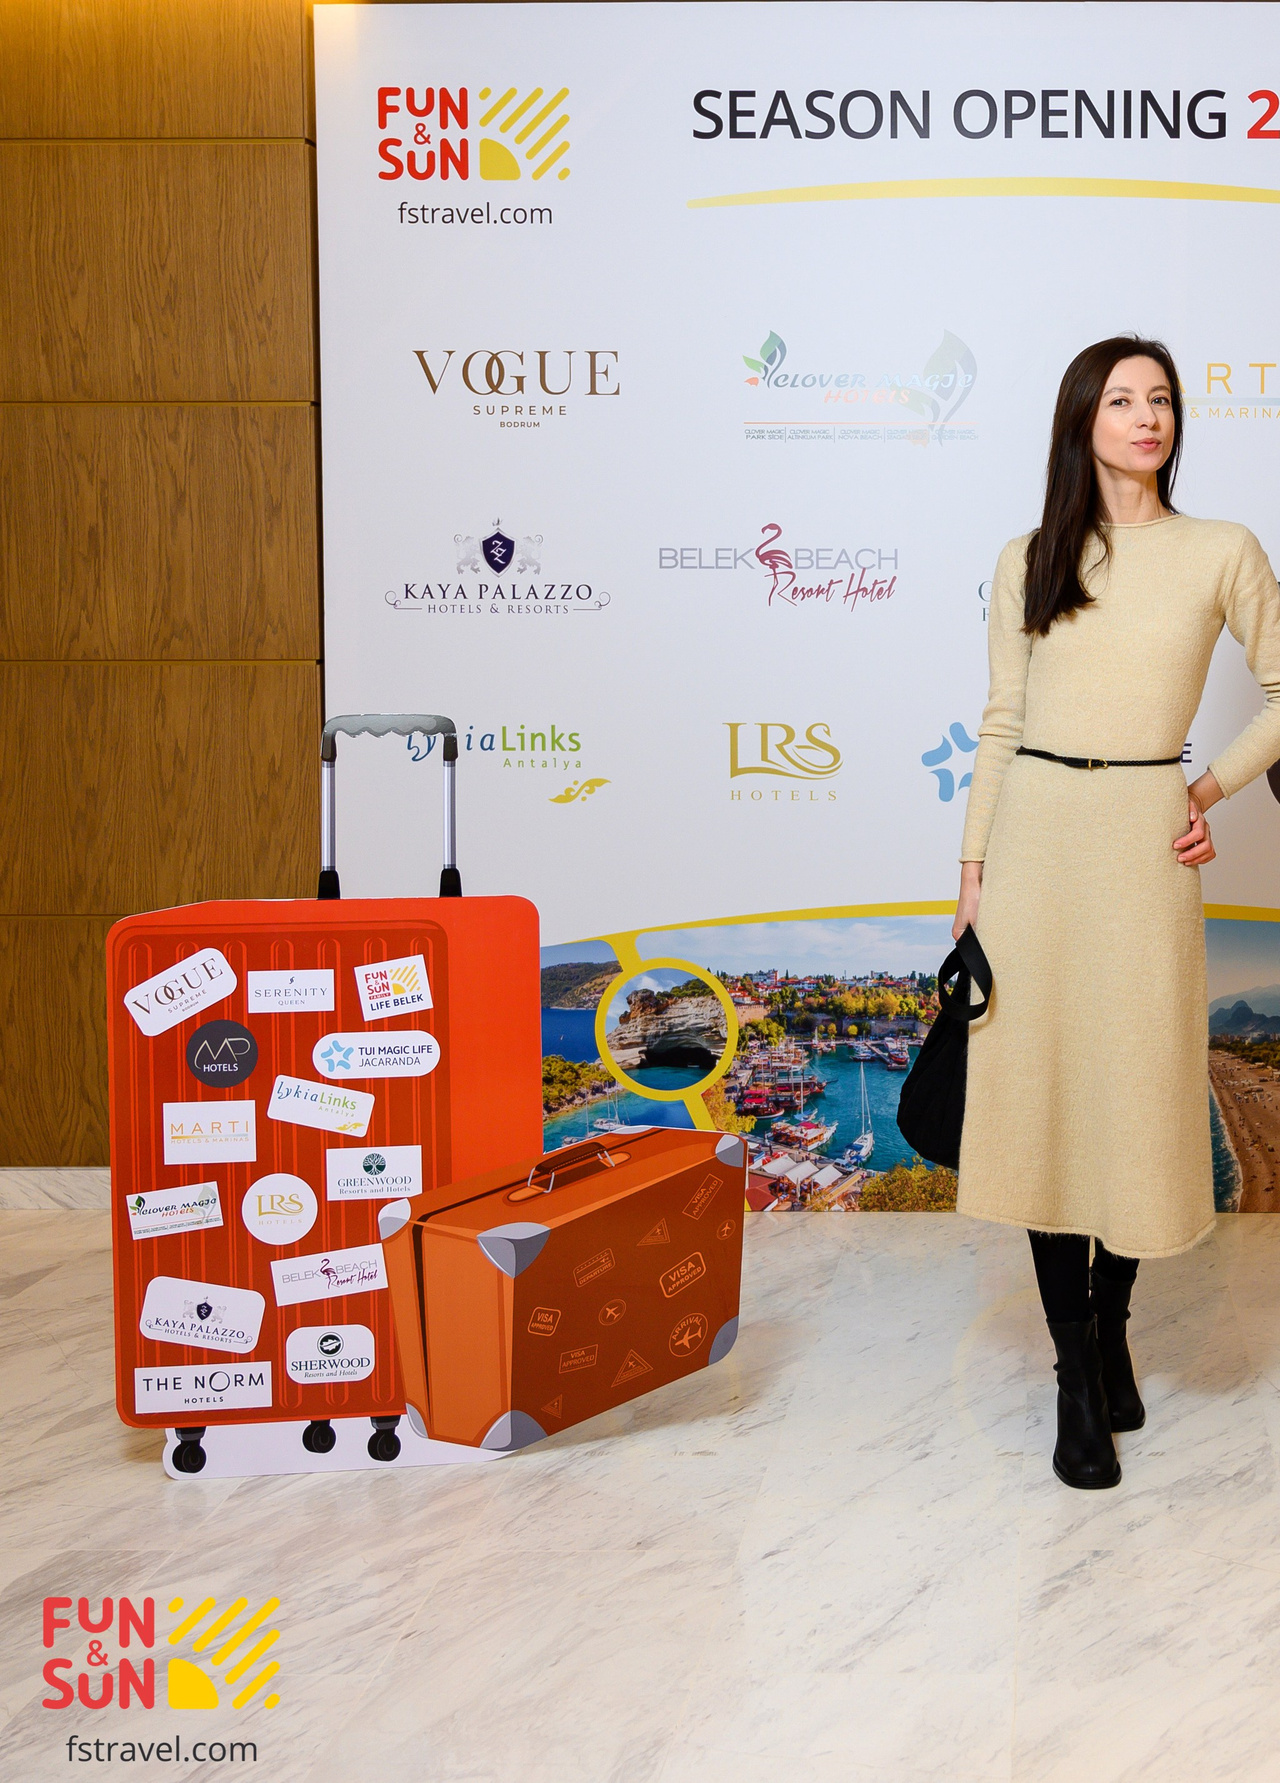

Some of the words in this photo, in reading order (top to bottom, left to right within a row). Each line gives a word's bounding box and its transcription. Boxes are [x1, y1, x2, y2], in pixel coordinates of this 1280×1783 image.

[378, 87, 468, 130] FUN
[692, 89, 931, 140] SEASON
[953, 89, 1227, 140] OPENING
[414, 123, 432, 144] &
[378, 138, 468, 180] SUN
[398, 202, 553, 224] fstravel.com
[412, 350, 620, 395] VOGUE
[774, 374, 866, 388] CLOVER
[875, 374, 973, 391] MAGIC
[473, 405, 567, 416] SUPREME
[1190, 408, 1200, 418] &
[659, 548, 755, 570] BELEK
[795, 548, 898, 570] BEACH
[404, 584, 468, 600] KAYA
[478, 584, 592, 600] PALAZZO
[765, 571, 843, 606] Resort
[843, 568, 897, 612] Hotel
[428, 604, 482, 614] HOTELS
[490, 604, 500, 614] &
[508, 604, 569, 614] RESORTS
[722, 722, 844, 780] LRS
[503, 758, 581, 770] Antalya
[731, 790, 836, 801] HOTELS
[364, 970, 387, 983] FUN
[132, 958, 223, 1015] VOGUE
[255, 988, 327, 998] SERENITY
[367, 982, 390, 995] SUN
[168, 989, 207, 1013] SUPREME
[370, 1000, 390, 1011] LIFE
[393, 994, 424, 1007] BELEK
[194, 1038, 250, 1069] MP
[358, 1047, 375, 1055] TUI
[378, 1046, 409, 1055] MAGIC
[413, 1045, 433, 1054] LIFE
[204, 1063, 238, 1072] HOTELS
[359, 1057, 421, 1067] JACARANDA
[319, 1106, 355, 1118] Antalya
[171, 1121, 248, 1135] MARTI
[338, 1176, 412, 1187] GREENWOOD
[142, 1205, 177, 1215] CLOVER
[255, 1194, 304, 1216] LRS
[282, 1269, 320, 1284] BELEK
[335, 1260, 378, 1274] BEACH
[357, 1269, 377, 1286] Hotel
[668, 1266, 702, 1293] APPROVED
[669, 1261, 695, 1282] VISA
[538, 1312, 553, 1323] VISA
[154, 1318, 186, 1330] KAYA
[190, 1323, 245, 1339] PALAZZO
[164, 1328, 191, 1337] HOTELS
[202, 1334, 232, 1343] RESORTS
[672, 1316, 702, 1340] ARRIVAL
[562, 1355, 594, 1368] APPROVED
[570, 1350, 585, 1358] VISA
[291, 1357, 370, 1371] SHERWOOD
[143, 1377, 182, 1391] THE
[194, 1371, 264, 1392] NORM
[184, 1396, 224, 1404] HOTELS
